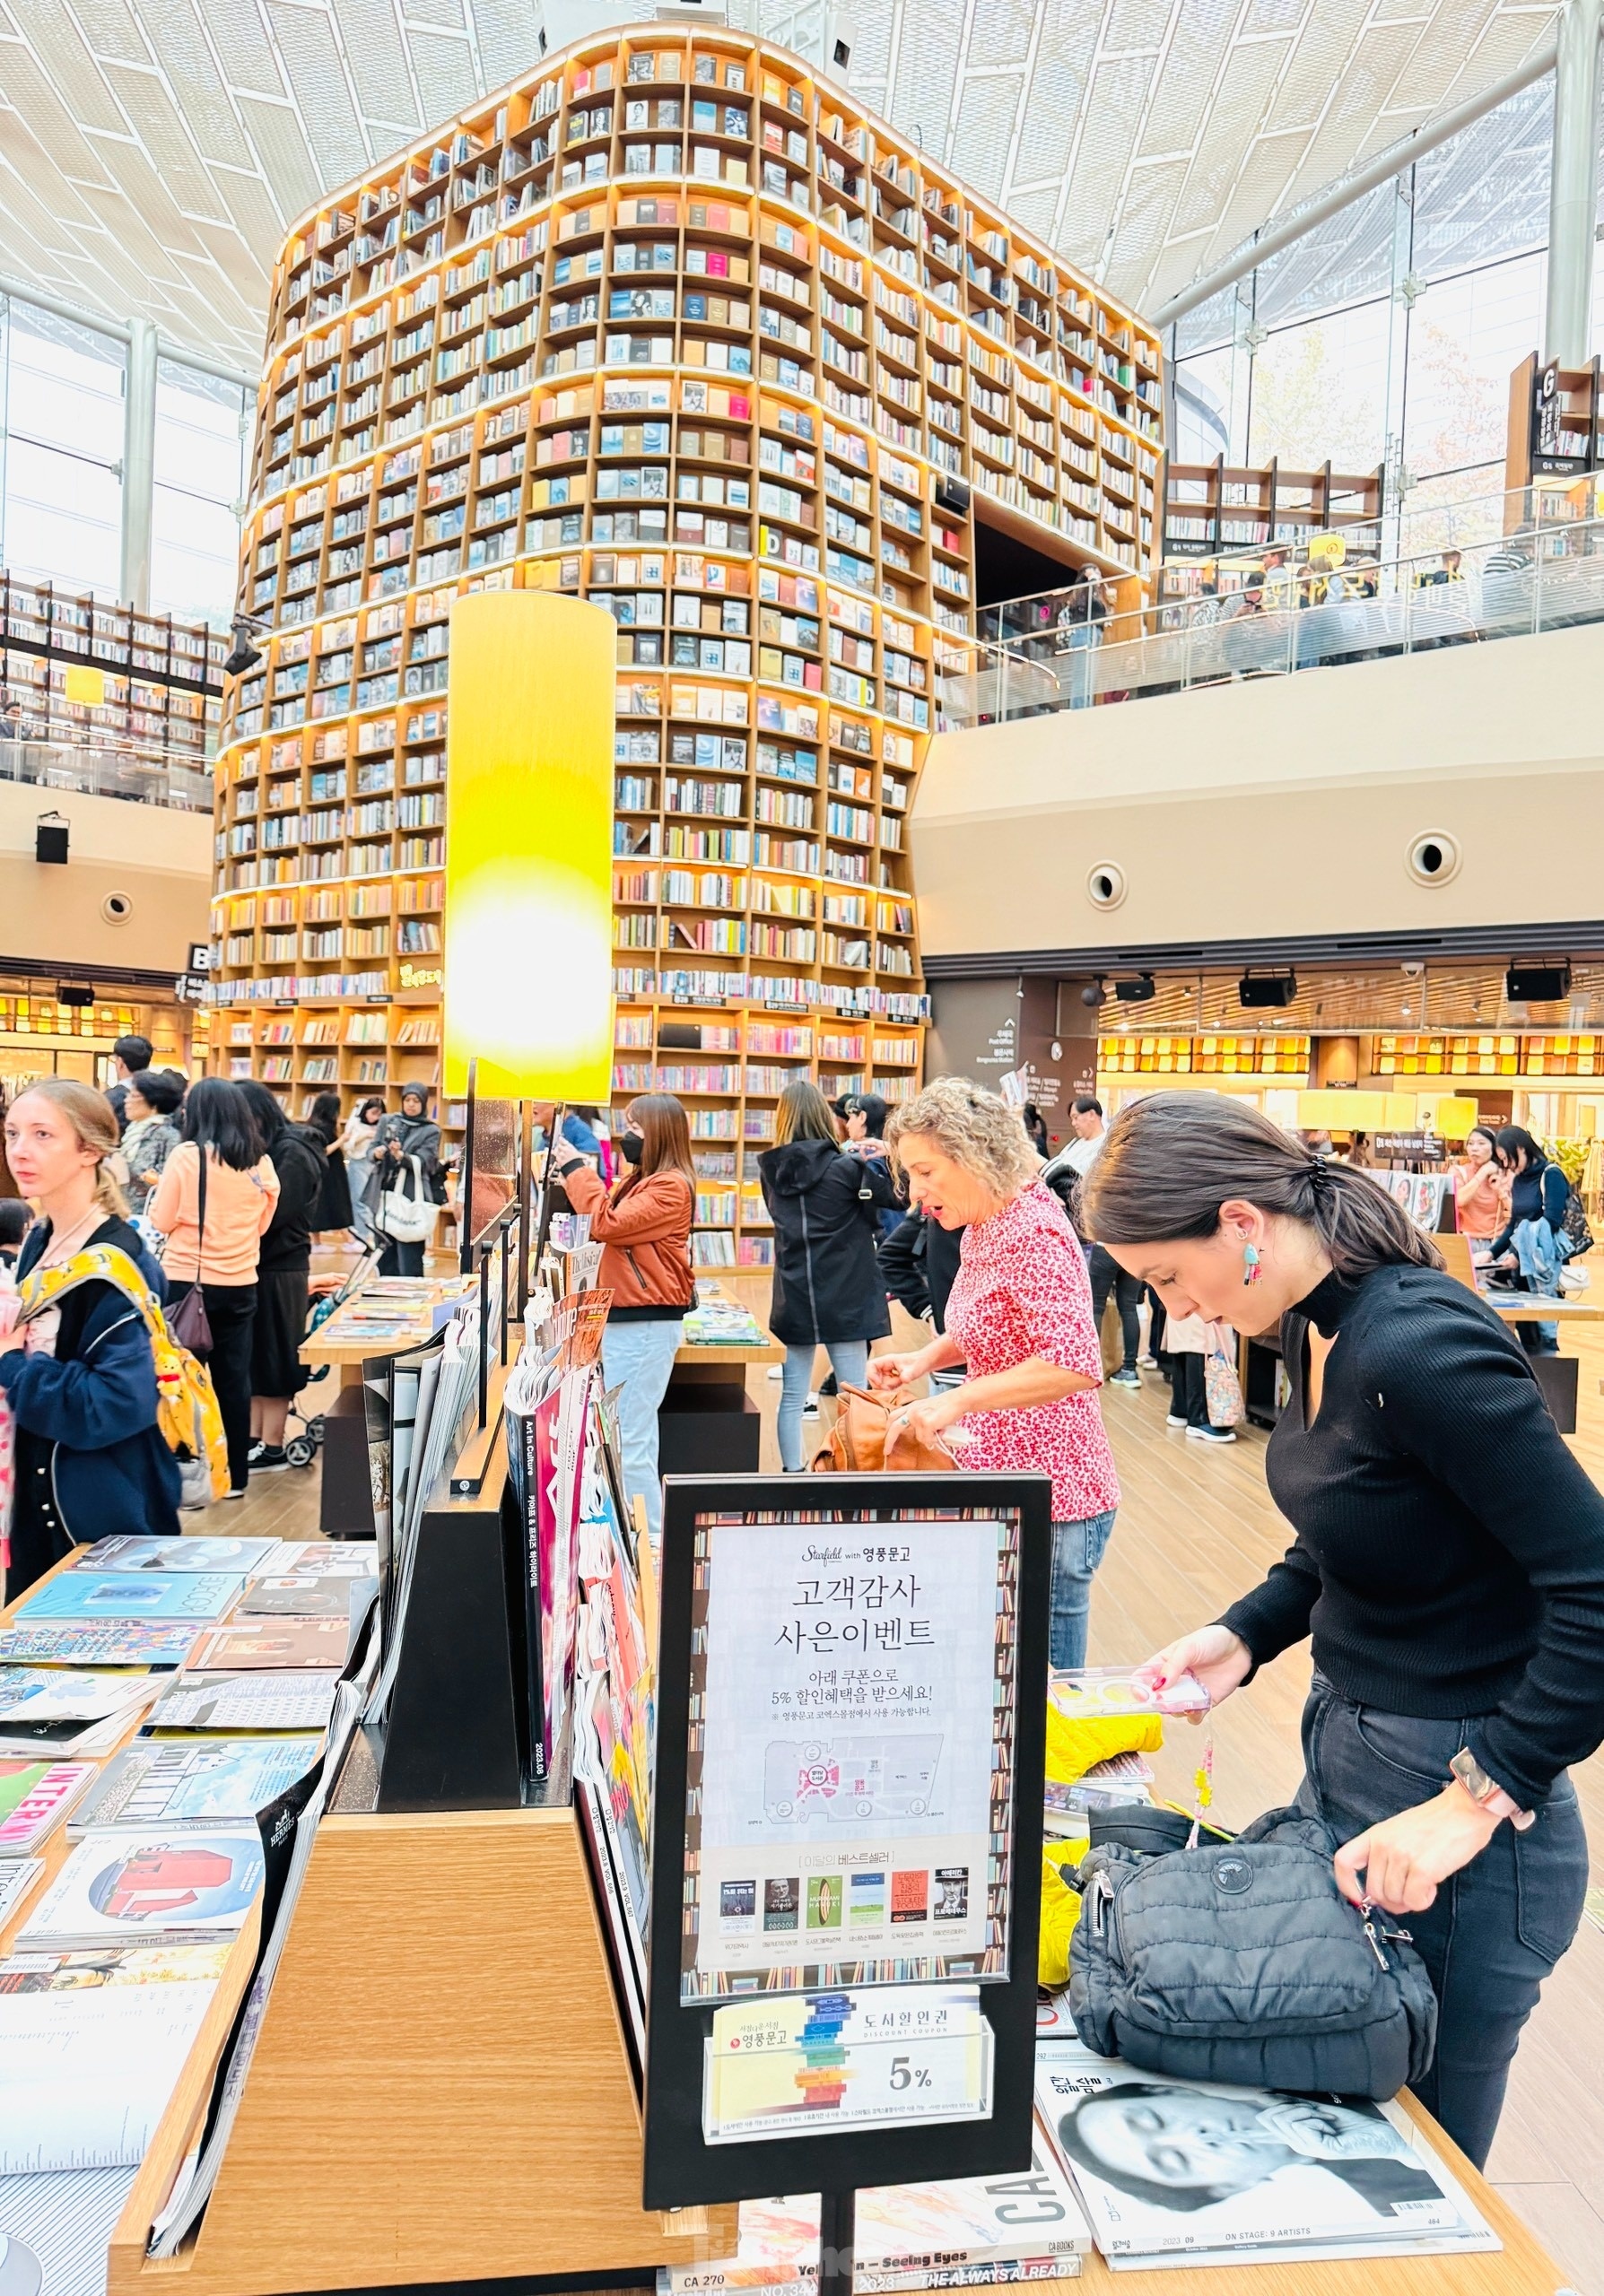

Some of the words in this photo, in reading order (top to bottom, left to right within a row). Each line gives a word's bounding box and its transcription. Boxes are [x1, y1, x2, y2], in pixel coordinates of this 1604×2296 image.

[1543, 369, 1555, 398] G
[193, 947, 210, 970] B
[526, 1446, 535, 1476] Culture
[527, 1494, 536, 1516] 키아프
[528, 1527, 536, 1549] 프리즈
[802, 1544, 842, 1568] Starfield
[863, 1546, 911, 1562] 영풍문고
[529, 1551, 538, 1587] 하이라이트
[792, 1574, 921, 1610] 고객감사
[774, 1618, 935, 1654] 사은이벤트
[809, 1669, 837, 1686] 아래
[841, 1668, 899, 1685] 쿠폰으로
[771, 1692, 791, 1704] 5%
[795, 1686, 867, 1706] 할인혜택을
[872, 1684, 933, 1700] 받으세요!
[782, 1710, 815, 1722] 영풍문고
[816, 1709, 871, 1719] 코엑스몰점에서
[874, 1708, 888, 1718] 사용
[535, 1743, 545, 1775] 2023.08
[804, 1855, 836, 1867] 이달의
[838, 1851, 890, 1866] 베스트셀러
[864, 2009, 947, 2029] 도서할인권
[743, 2031, 787, 2048] 영풍문고
[863, 2030, 907, 2038] DISCOUNT
[889, 2057, 932, 2091] 5%
[1163, 2238, 1181, 2246] 2023
[1240, 2231, 1268, 2239] STAGE:
[1269, 2230, 1275, 2238] 9
[1277, 2228, 1311, 2237] ARTISTS
[1048, 2242, 1057, 2252] CA
[1057, 2240, 1075, 2251] BOOKS
[883, 2255, 931, 2268] Seeing
[934, 2251, 967, 2264] Eyes
[684, 2277, 699, 2287] CA
[703, 2274, 725, 2285] 270
[859, 2276, 895, 2291] 2023
[920, 2274, 951, 2289] THE
[951, 2269, 1015, 2285] ALWAYS
[1012, 2264, 1077, 2281] ALREADY
